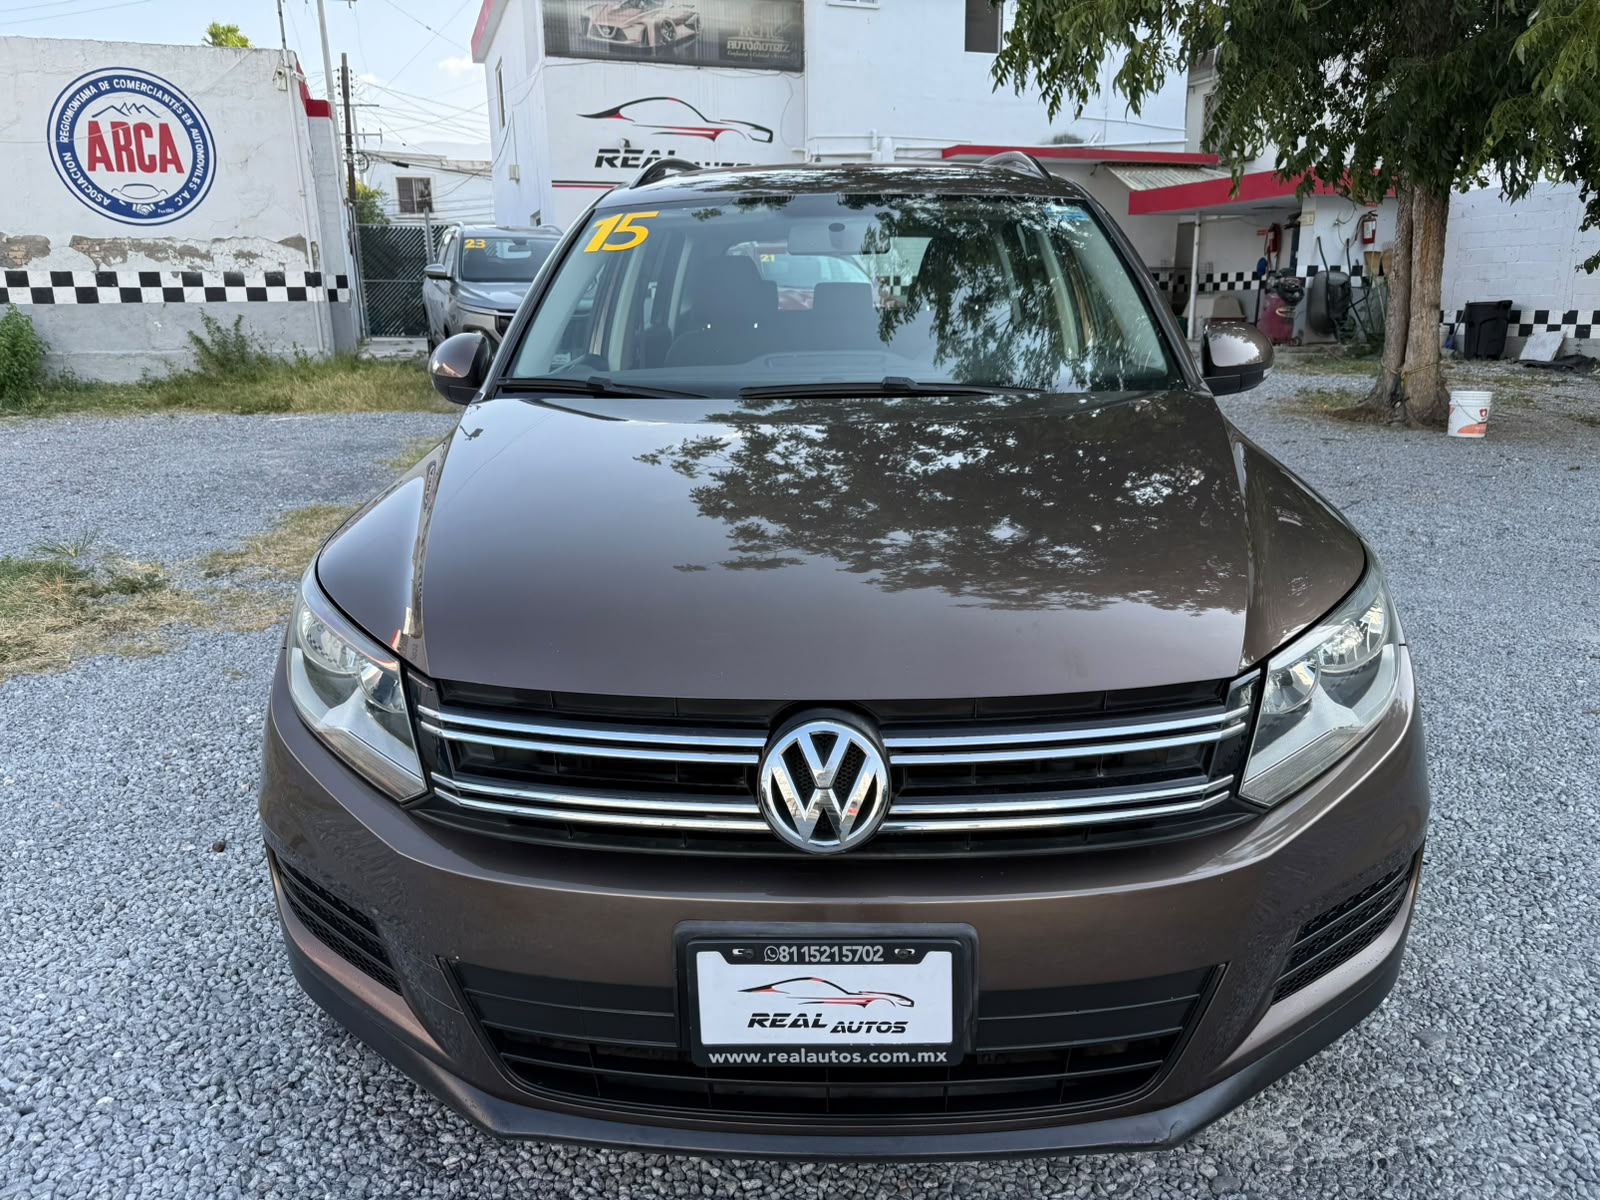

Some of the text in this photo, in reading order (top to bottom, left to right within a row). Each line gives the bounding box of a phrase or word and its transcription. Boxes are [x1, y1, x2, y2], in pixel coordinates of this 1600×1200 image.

[98, 80, 111, 92] DE
[113, 78, 185, 115] COMERCIANTES
[59, 85, 98, 143] REGIOMONTANA
[181, 112, 195, 126] EN
[87, 120, 185, 174] ARCA
[189, 127, 206, 191] AUTOMOVILES
[62, 151, 112, 206] ASOCIACION
[583, 210, 659, 253] 15
[464, 239, 486, 249] 23
[760, 254, 776, 263] 21
[778, 945, 884, 963] 8115215702
[747, 1013, 909, 1034] REAL AUTOS
[708, 1048, 948, 1064] www.realautos.com.mx
